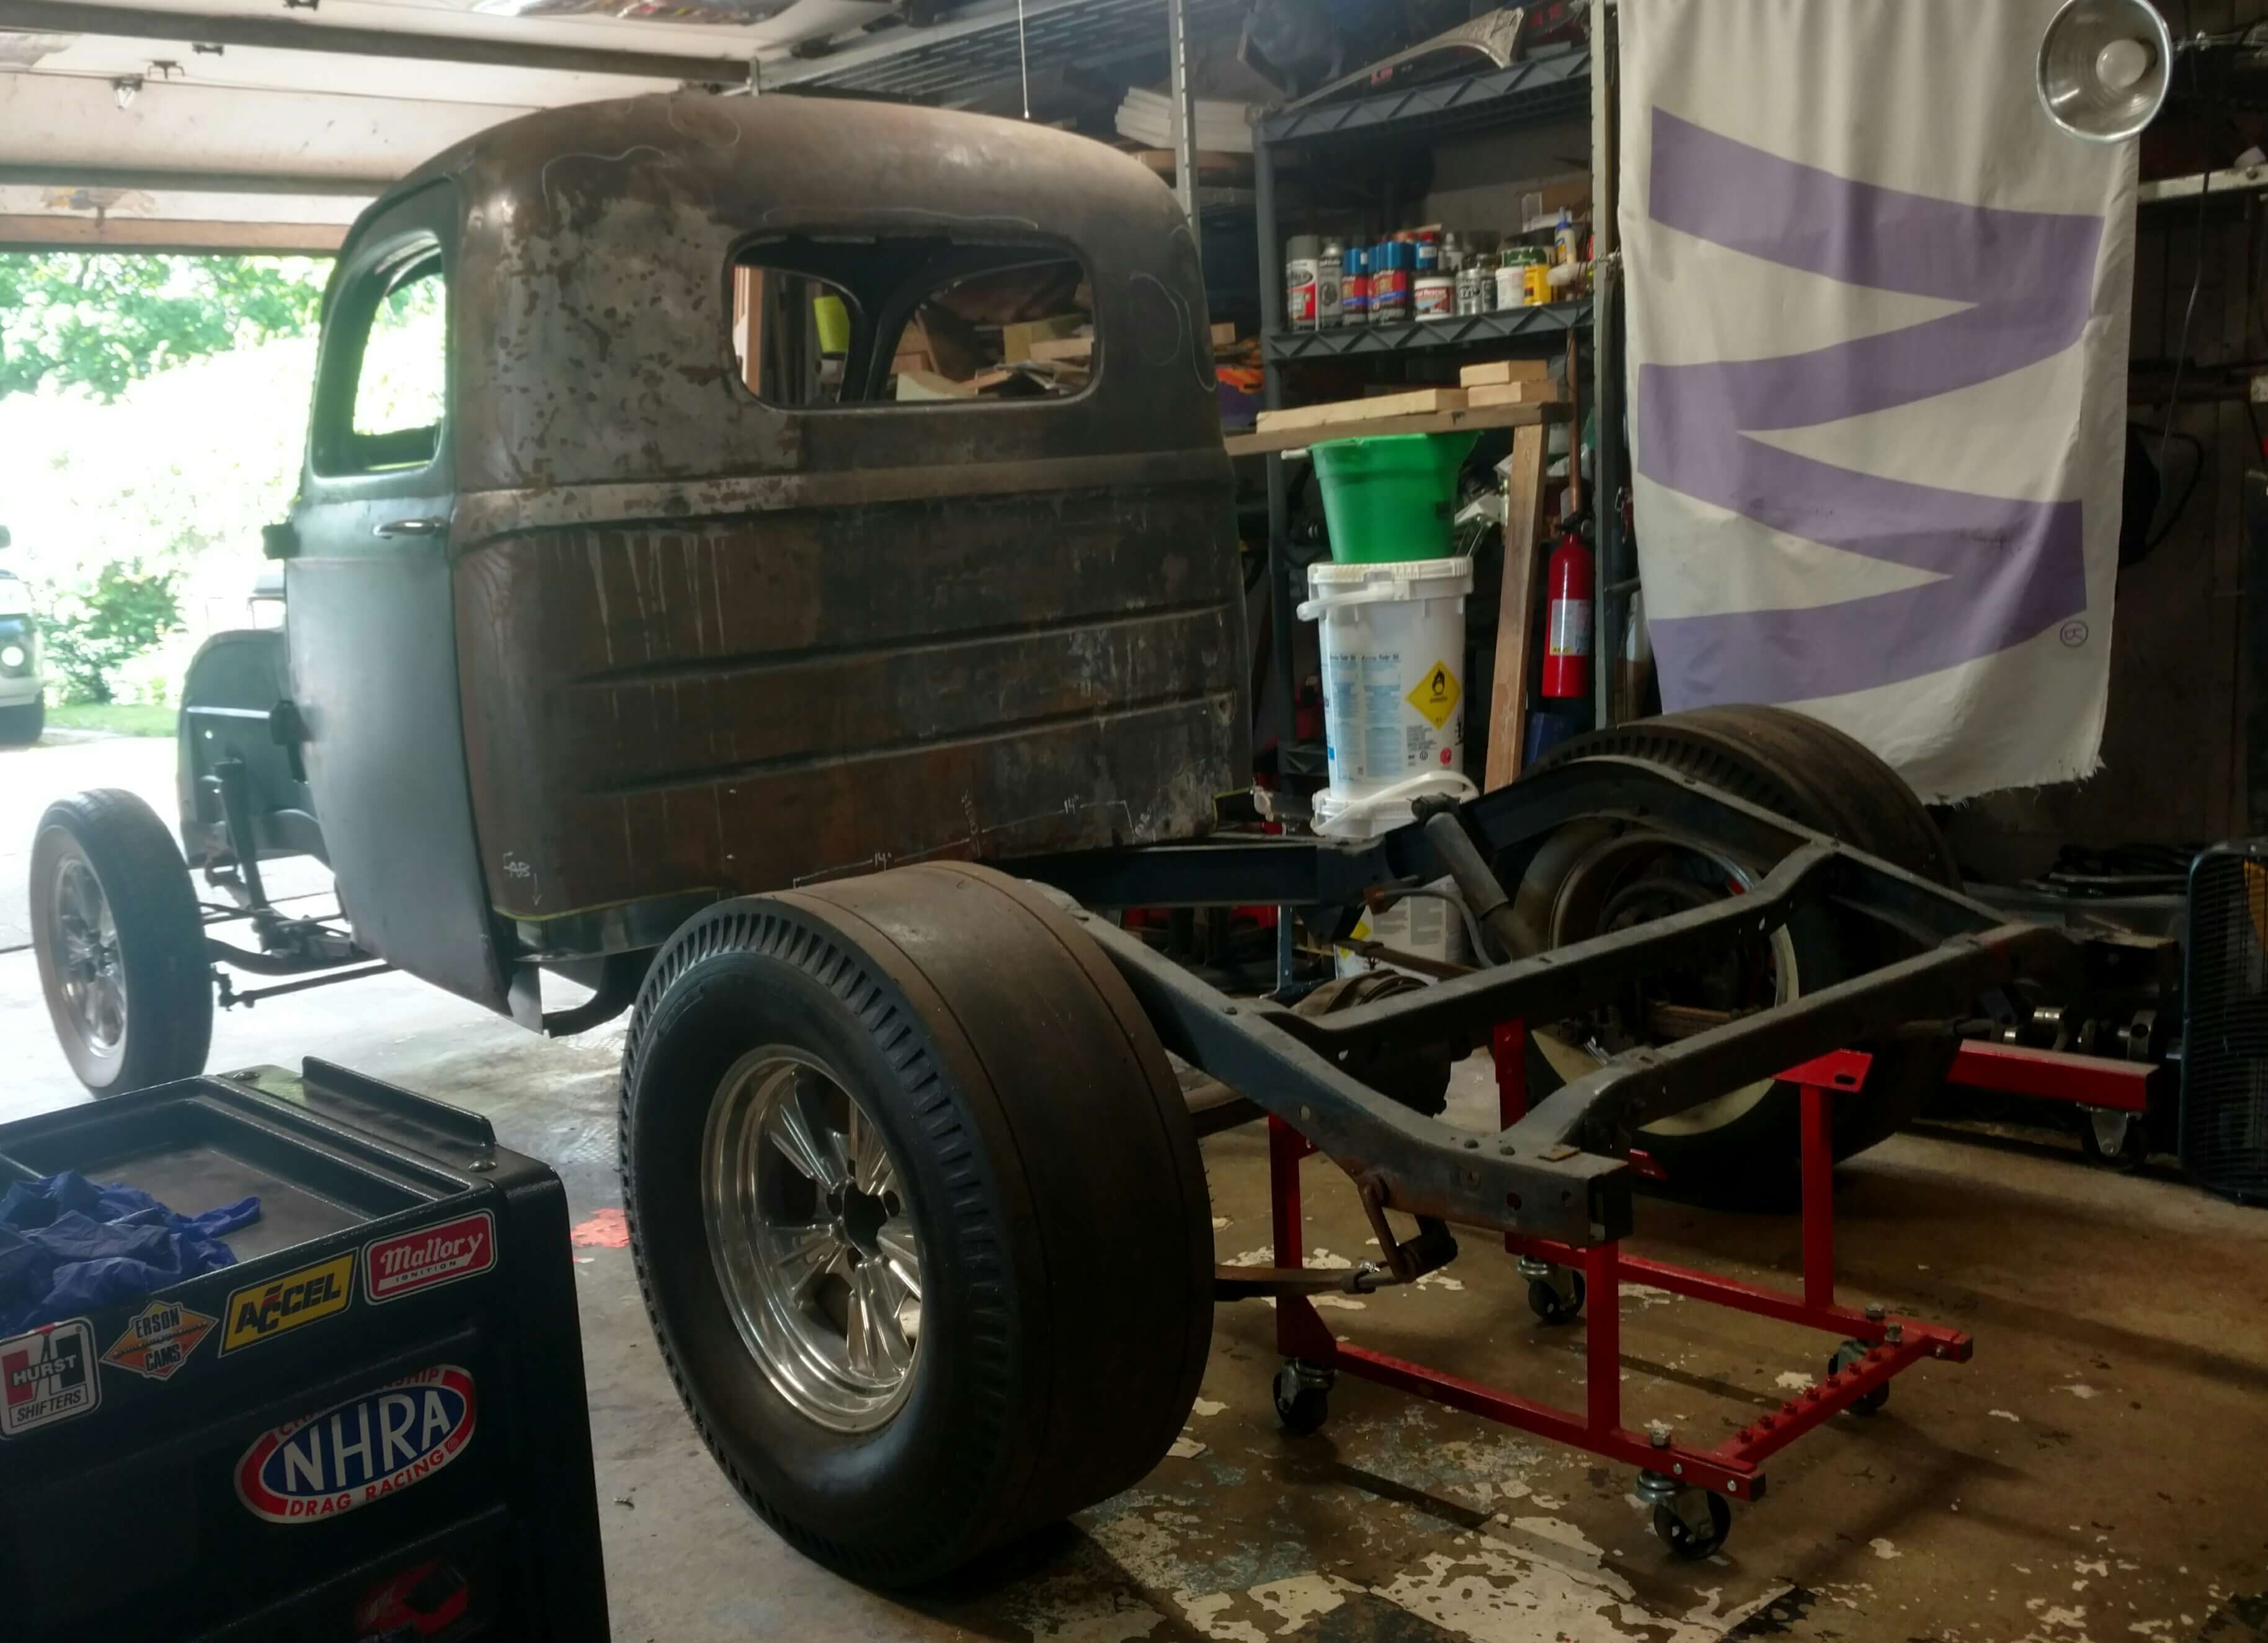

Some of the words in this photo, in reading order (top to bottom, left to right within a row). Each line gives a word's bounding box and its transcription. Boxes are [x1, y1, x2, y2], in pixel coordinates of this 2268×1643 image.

[380, 1232, 484, 1275] Mallory
[396, 1260, 457, 1283] IGNITION
[234, 1273, 342, 1334] ACCEL
[135, 1307, 180, 1339] ERSON
[12, 1354, 77, 1386] HURST
[145, 1343, 182, 1371] CAMS
[17, 1389, 82, 1422] SHIFTERS
[283, 1390, 451, 1492] NHRA
[289, 1494, 352, 1517] DRAG
[365, 1448, 445, 1501] RACING
